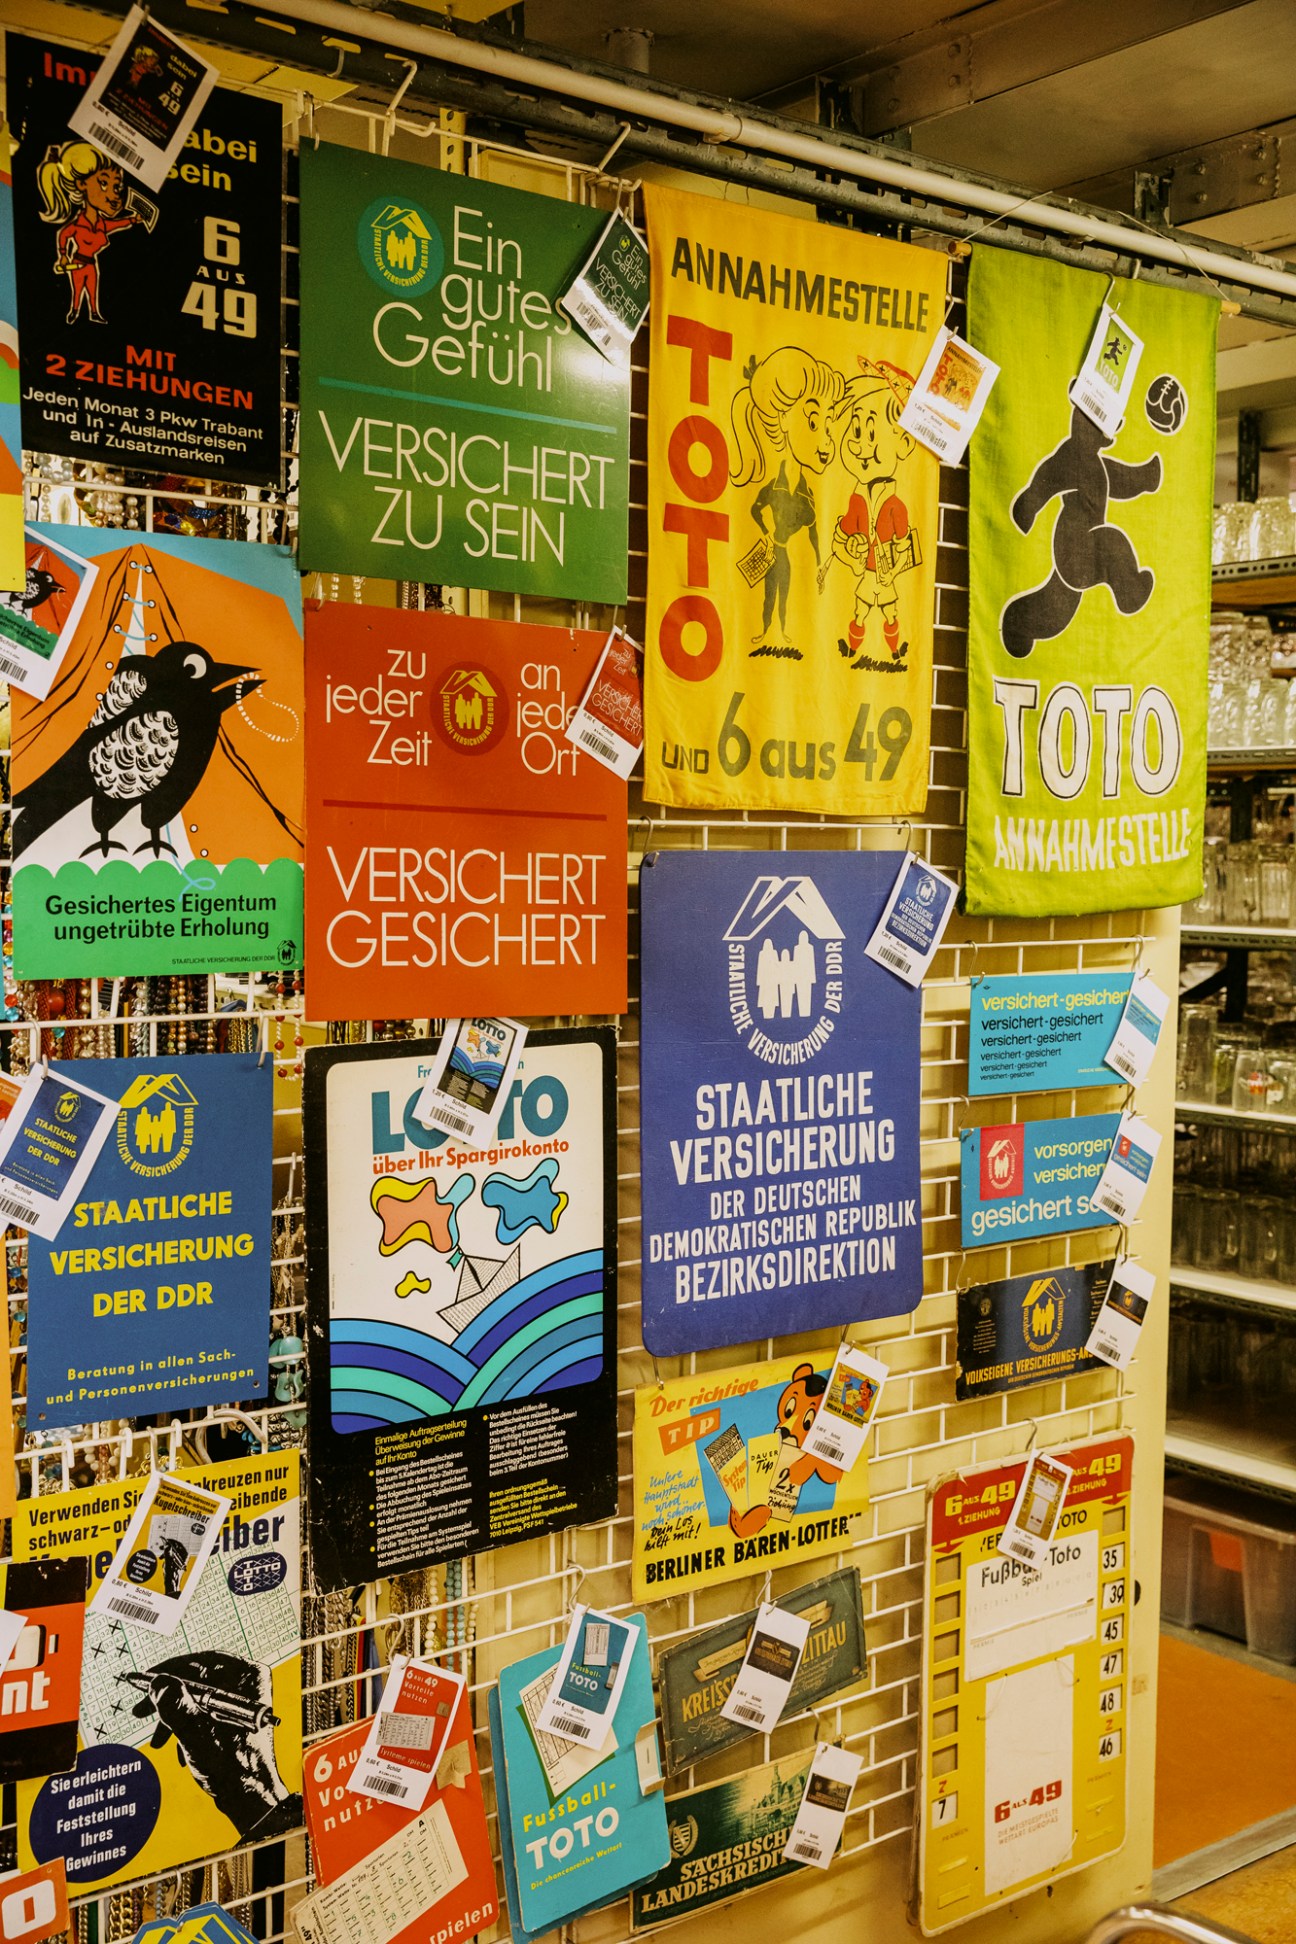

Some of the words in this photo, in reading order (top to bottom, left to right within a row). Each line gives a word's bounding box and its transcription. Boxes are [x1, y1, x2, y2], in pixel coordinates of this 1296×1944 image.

[43, 52, 95, 88] Im
[169, 54, 198, 78] dabei
[187, 128, 257, 164] abei
[203, 216, 240, 267] 6
[453, 205, 522, 279] Ein
[631, 245, 645, 266] Ein
[196, 266, 246, 285] AUS
[611, 250, 641, 290] Gefühl
[625, 254, 647, 284] gutes
[671, 236, 929, 333] ANNAHMESTELLE
[441, 273, 571, 336] gutes
[595, 257, 641, 320] VERSICHERT
[595, 278, 610, 298] ZU
[607, 296, 629, 321] SEIN
[181, 282, 257, 339] 49
[126, 345, 177, 373] MIT
[372, 301, 552, 392] Gefühl
[45, 354, 66, 377] 2
[74, 359, 254, 410] ZIEHUNGEN
[22, 386, 79, 408] Jeden
[84, 396, 139, 420] Monat
[145, 408, 155, 422] 3
[160, 410, 197, 429] Pkw
[201, 417, 263, 440] Trabant
[43, 407, 79, 426] und
[120, 422, 247, 453] Auslandsreisen
[69, 427, 101, 445] auf
[105, 434, 225, 465] Zusatzmarken
[318, 410, 615, 510] VERSICHERT
[659, 314, 733, 682] TOTO
[371, 485, 443, 549] ZU
[463, 498, 565, 567] SEIN
[387, 649, 427, 680] zu
[520, 662, 560, 691] an
[326, 674, 423, 723] jeder
[516, 691, 579, 738] jede
[592, 693, 643, 736] GESICHERT
[367, 719, 432, 767] Zeit
[661, 741, 709, 775] UND
[717, 691, 751, 777] 6
[759, 738, 837, 781] aus
[843, 702, 913, 782] 49
[993, 675, 1183, 801] TOTO
[521, 731, 581, 777] Ort
[326, 845, 607, 905] VERSICHERT
[45, 894, 175, 917] Gesichertes
[182, 893, 276, 916] Eigentum
[54, 920, 175, 943] ungetrübte
[181, 918, 269, 939] Erholung
[325, 909, 606, 968] GESICHERT
[825, 941, 843, 975] DDR
[728, 943, 754, 1035] STAATLICHE
[824, 981, 843, 1013] DER
[471, 1018, 506, 1041] LOTTO
[747, 1015, 835, 1066] VERSICHERUNG
[184, 1107, 194, 1126] DDR
[371, 1075, 569, 1154] LOTO
[696, 1071, 874, 1131] STAATLICHE
[23, 1127, 77, 1159] VERSICHERUNG
[34, 1117, 78, 1144] STAATLICHE
[117, 1110, 134, 1165] STAATLICHE
[183, 1128, 194, 1146] DER
[27, 1145, 43, 1159] DER
[43, 1153, 60, 1167] DDR
[130, 1146, 190, 1177] VERSICHERUNG
[373, 1155, 415, 1175] über
[419, 1152, 442, 1169] Ihr
[446, 1139, 569, 1169] Spargirokonto
[670, 1118, 895, 1186] VERSICHERUNG
[1034, 1137, 1112, 1159] vorsorgen
[14, 1184, 32, 1196] Schild
[710, 1189, 745, 1221] DER
[754, 1174, 861, 1216] DEUTSCHEN
[73, 1191, 232, 1228] STAATLICHE
[971, 1195, 1072, 1237] gesichert
[650, 1213, 817, 1264] DEMOKRATISCHEN
[826, 1199, 917, 1238] REPUBLIK
[49, 1233, 254, 1275] VERSICHERUNG
[675, 1235, 896, 1305] BEZIRKSDIREKTION
[93, 1290, 147, 1317] DER
[157, 1282, 213, 1311] DDR
[67, 1362, 135, 1381] Beratung
[140, 1359, 153, 1372] in
[158, 1354, 194, 1370] allen
[199, 1349, 237, 1365] Sach-
[965, 1361, 1013, 1386] VOLKSEIGENE
[1016, 1346, 1094, 1373] VERSICHERUNGS-ANS
[46, 1390, 74, 1405] und
[78, 1367, 254, 1401] Personenversicherungen
[650, 1395, 686, 1418] Der
[689, 1378, 759, 1408] richtige
[375, 1432, 408, 1445] Einmalige
[409, 1420, 467, 1437] Auftragserteilung
[375, 1440, 421, 1455] Überweisung
[434, 1430, 465, 1442] Gewinne
[667, 1415, 716, 1446] TIP
[397, 1450, 417, 1460] Konto
[751, 1450, 778, 1461] DAUER
[756, 1458, 774, 1474] Tip
[1088, 1453, 1122, 1476] 49
[29, 1498, 119, 1527] Verwenden
[265, 1466, 289, 1482] nur
[229, 1486, 288, 1511] eibende
[732, 1477, 746, 1493] Tip
[945, 1494, 962, 1517] 6
[963, 1495, 980, 1506] AUS
[981, 1480, 1016, 1505] 49
[153, 1495, 210, 1525] Kugelschreiber
[675, 1515, 693, 1530] Los
[644, 1534, 669, 1551] hilft
[673, 1522, 701, 1541] mit!
[234, 1562, 281, 1579] LOTTO
[646, 1545, 725, 1585] BERLINER
[1103, 1550, 1117, 1569] 35
[135, 1587, 152, 1597] Schild
[1021, 1572, 1043, 1588] Spiel
[1109, 1584, 1124, 1604] 39
[802, 1621, 847, 1665] ZITTAU
[1104, 1621, 1118, 1641] 45
[406, 1669, 414, 1680] 6
[424, 1678, 438, 1688] 49
[569, 1671, 599, 1691] TOTO
[571, 1662, 602, 1678] Fussball-
[1103, 1654, 1118, 1675] 47
[1, 1670, 50, 1716] nt
[402, 1690, 428, 1704] nutzen
[404, 1681, 434, 1697] Vorteile
[1100, 1692, 1114, 1714] 48
[380, 1747, 405, 1762] Systeme
[408, 1755, 431, 1770] spielen
[1099, 1738, 1113, 1757] 46
[51, 1779, 70, 1794] Sie
[73, 1760, 141, 1789] erleichtern
[314, 1754, 333, 1783] 6
[386, 1764, 402, 1773] Schild
[68, 1794, 104, 1810] damit
[107, 1784, 126, 1801] die
[522, 1780, 617, 1833] Fussball-
[938, 1799, 946, 1820] 7
[994, 1800, 1011, 1824] 6
[1028, 1779, 1062, 1806] 49
[57, 1801, 136, 1834] Feststellung
[324, 1797, 385, 1832] nutz
[80, 1829, 113, 1847] Ihres
[525, 1806, 620, 1870] TOTO
[680, 1827, 793, 1882] SÄCHSISCH
[66, 1845, 126, 1872] Gewinnes
[530, 1877, 543, 1891] Die
[545, 1854, 595, 1884] chancenreiche
[596, 1841, 622, 1860] Wettart
